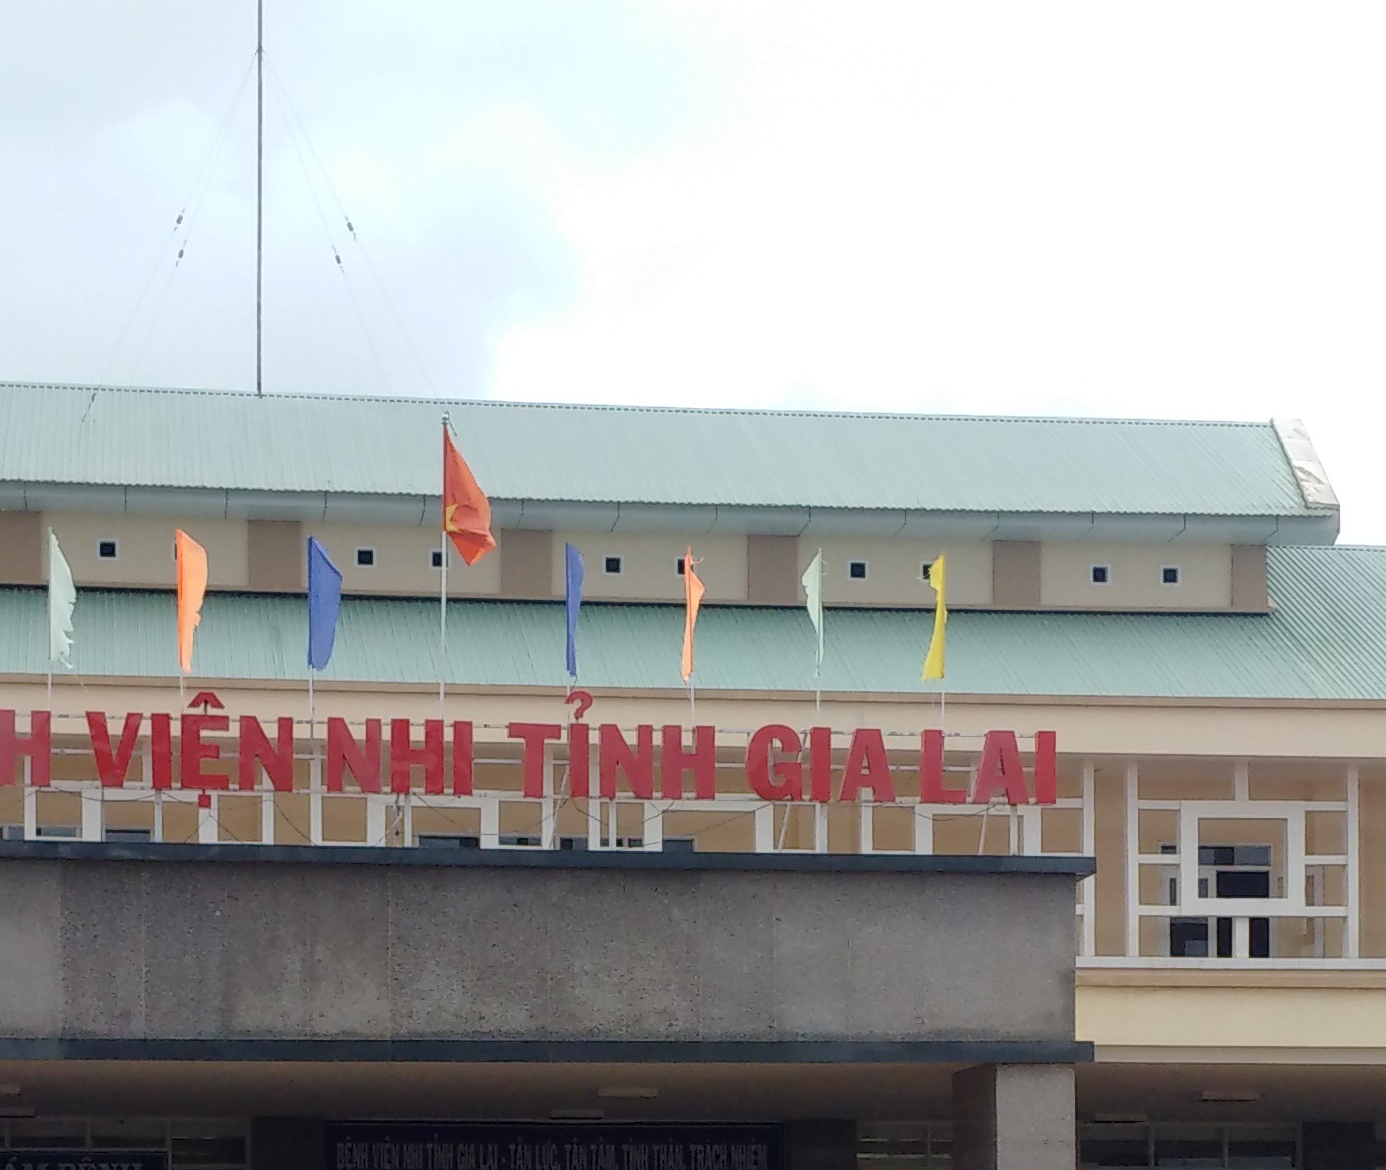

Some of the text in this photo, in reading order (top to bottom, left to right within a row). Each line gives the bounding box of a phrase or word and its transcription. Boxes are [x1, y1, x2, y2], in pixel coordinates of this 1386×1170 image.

[84, 691, 294, 808] VIỆN
[326, 715, 472, 795] NHI
[507, 690, 715, 801] TỈNH
[745, 723, 896, 802] GIA
[920, 729, 1057, 805] LAI
[403, 1143, 423, 1170] NHI
[457, 1143, 475, 1170] GIA
[480, 1143, 498, 1170] LAI
